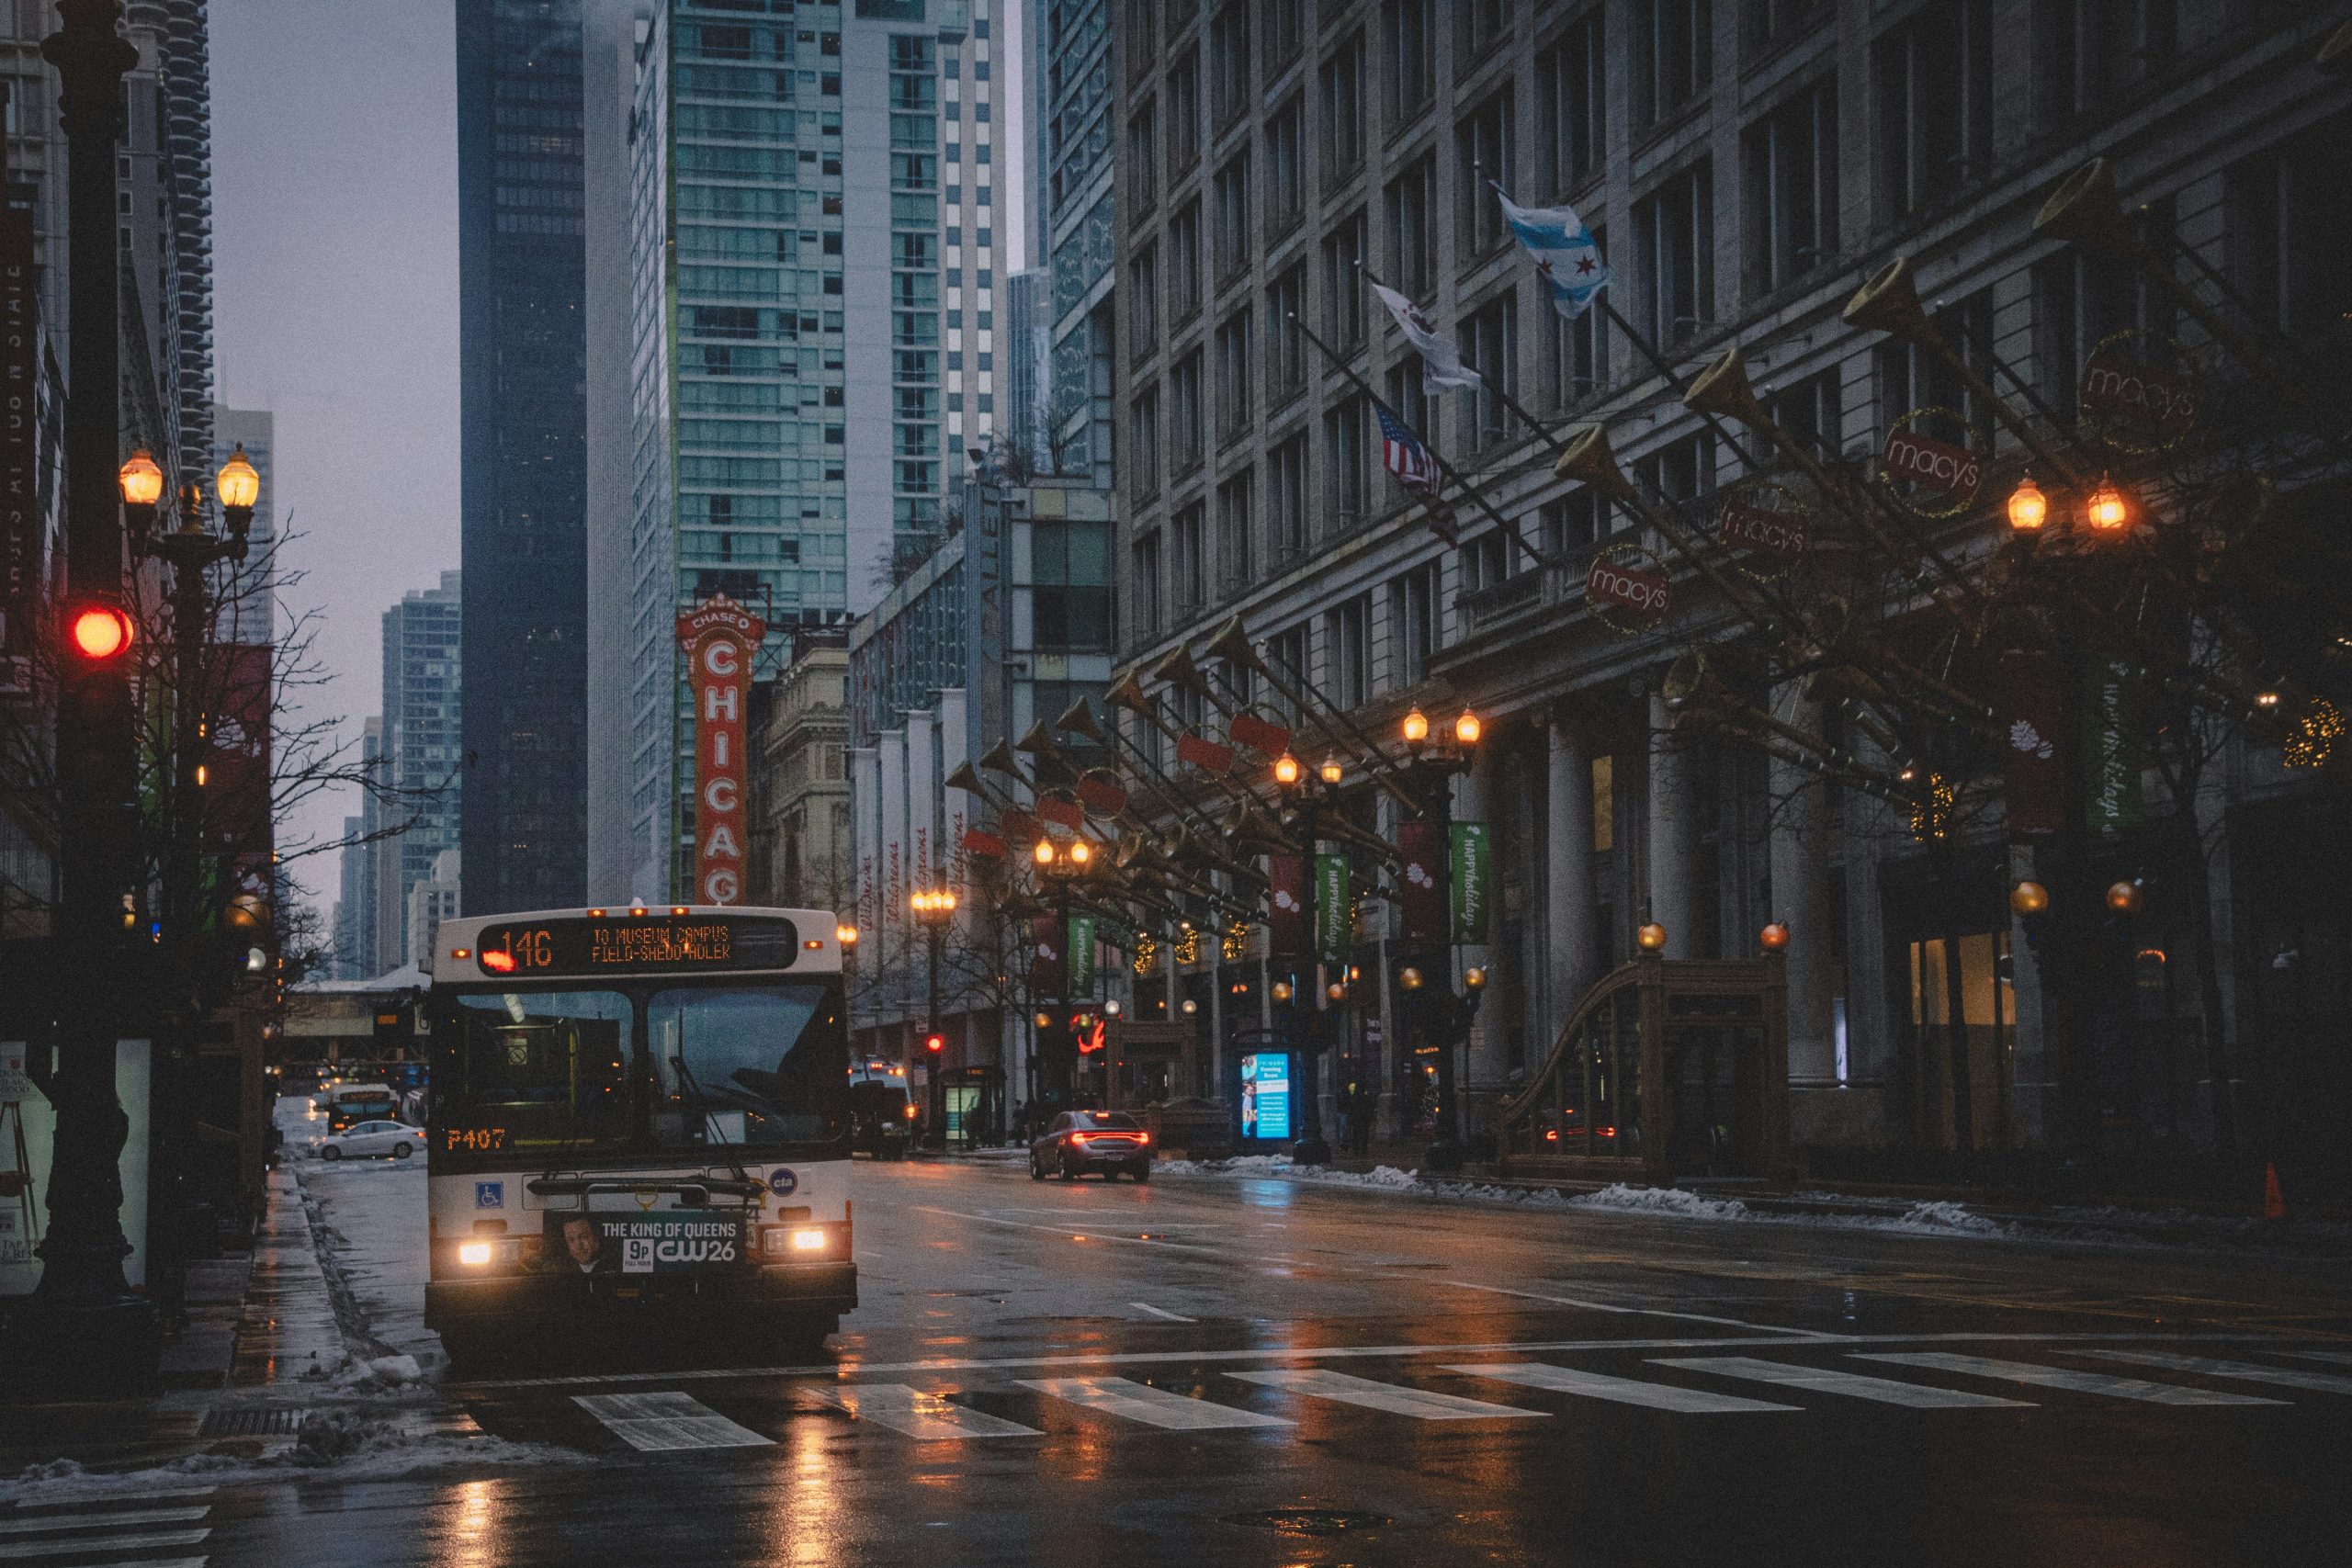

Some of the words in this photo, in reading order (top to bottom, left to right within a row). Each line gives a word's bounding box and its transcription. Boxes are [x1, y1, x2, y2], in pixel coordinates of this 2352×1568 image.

[692, 613, 737, 628] CHASE
[887, 841, 903, 921] Walgreens
[860, 855, 876, 931] Walgreens
[594, 929, 608, 943] TO
[616, 927, 671, 943] MUSEUM
[677, 926, 729, 943] CAMPUS
[501, 930, 552, 967] 146
[447, 1128, 505, 1150] P407
[773, 1177, 794, 1188] cta
[602, 1223, 627, 1237] THE
[630, 1223, 662, 1237] KING
[665, 1223, 682, 1237] OF
[684, 1223, 737, 1239] QUEENS
[629, 1241, 649, 1259] 9P
